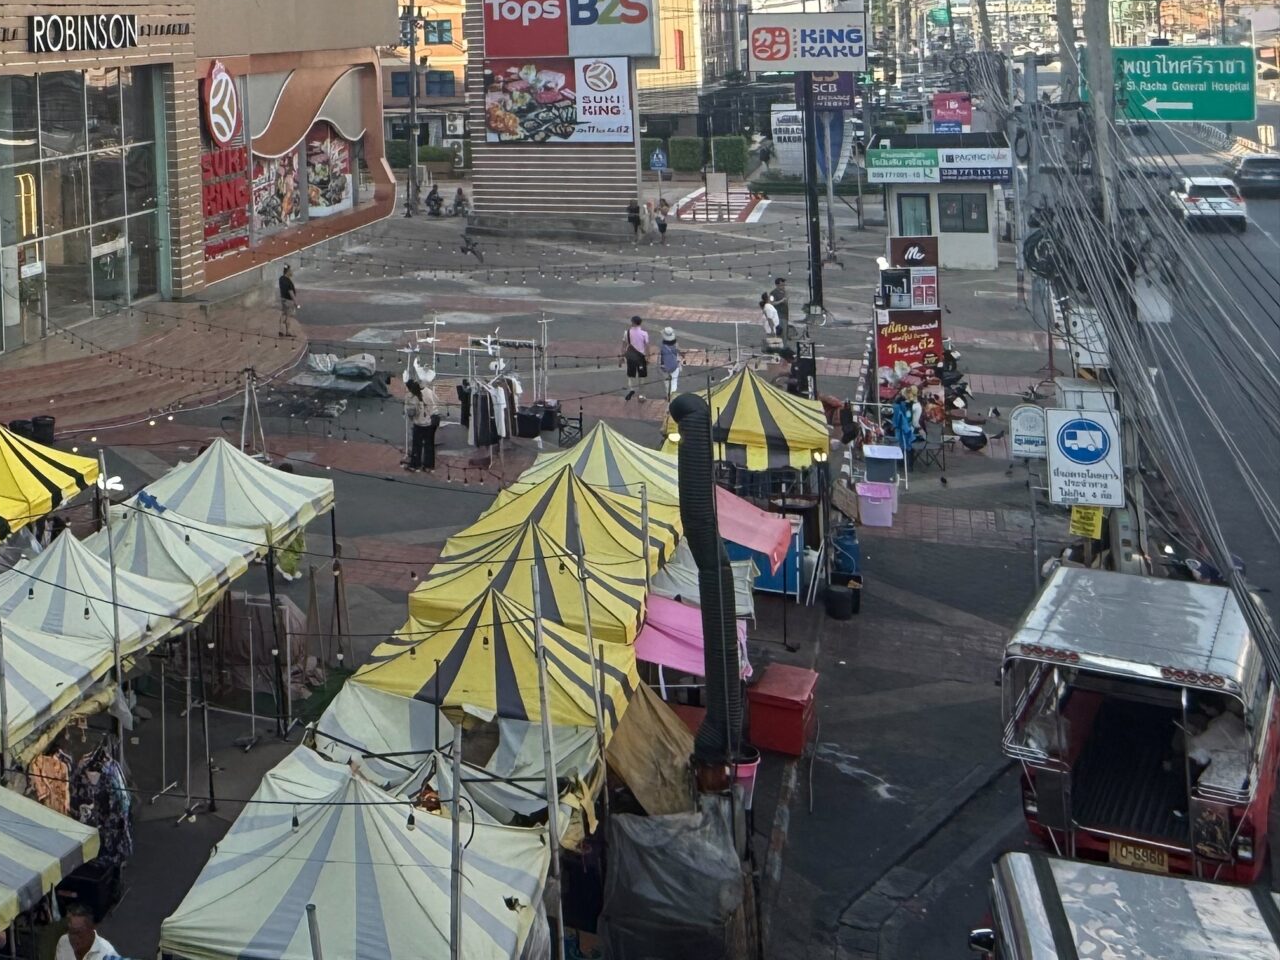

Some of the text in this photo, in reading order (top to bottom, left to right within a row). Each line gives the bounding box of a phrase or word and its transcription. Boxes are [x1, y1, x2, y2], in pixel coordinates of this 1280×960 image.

[33, 14, 138, 53] ROBINSON
[801, 46, 864, 58] KAKU
[812, 83, 837, 93] SCB
[1140, 81, 1168, 91] Racha
[1172, 81, 1207, 91] General
[1211, 81, 1250, 93] Hospital
[582, 95, 620, 104] SUKI
[582, 105, 621, 116] KING
[201, 145, 248, 181] SUKI
